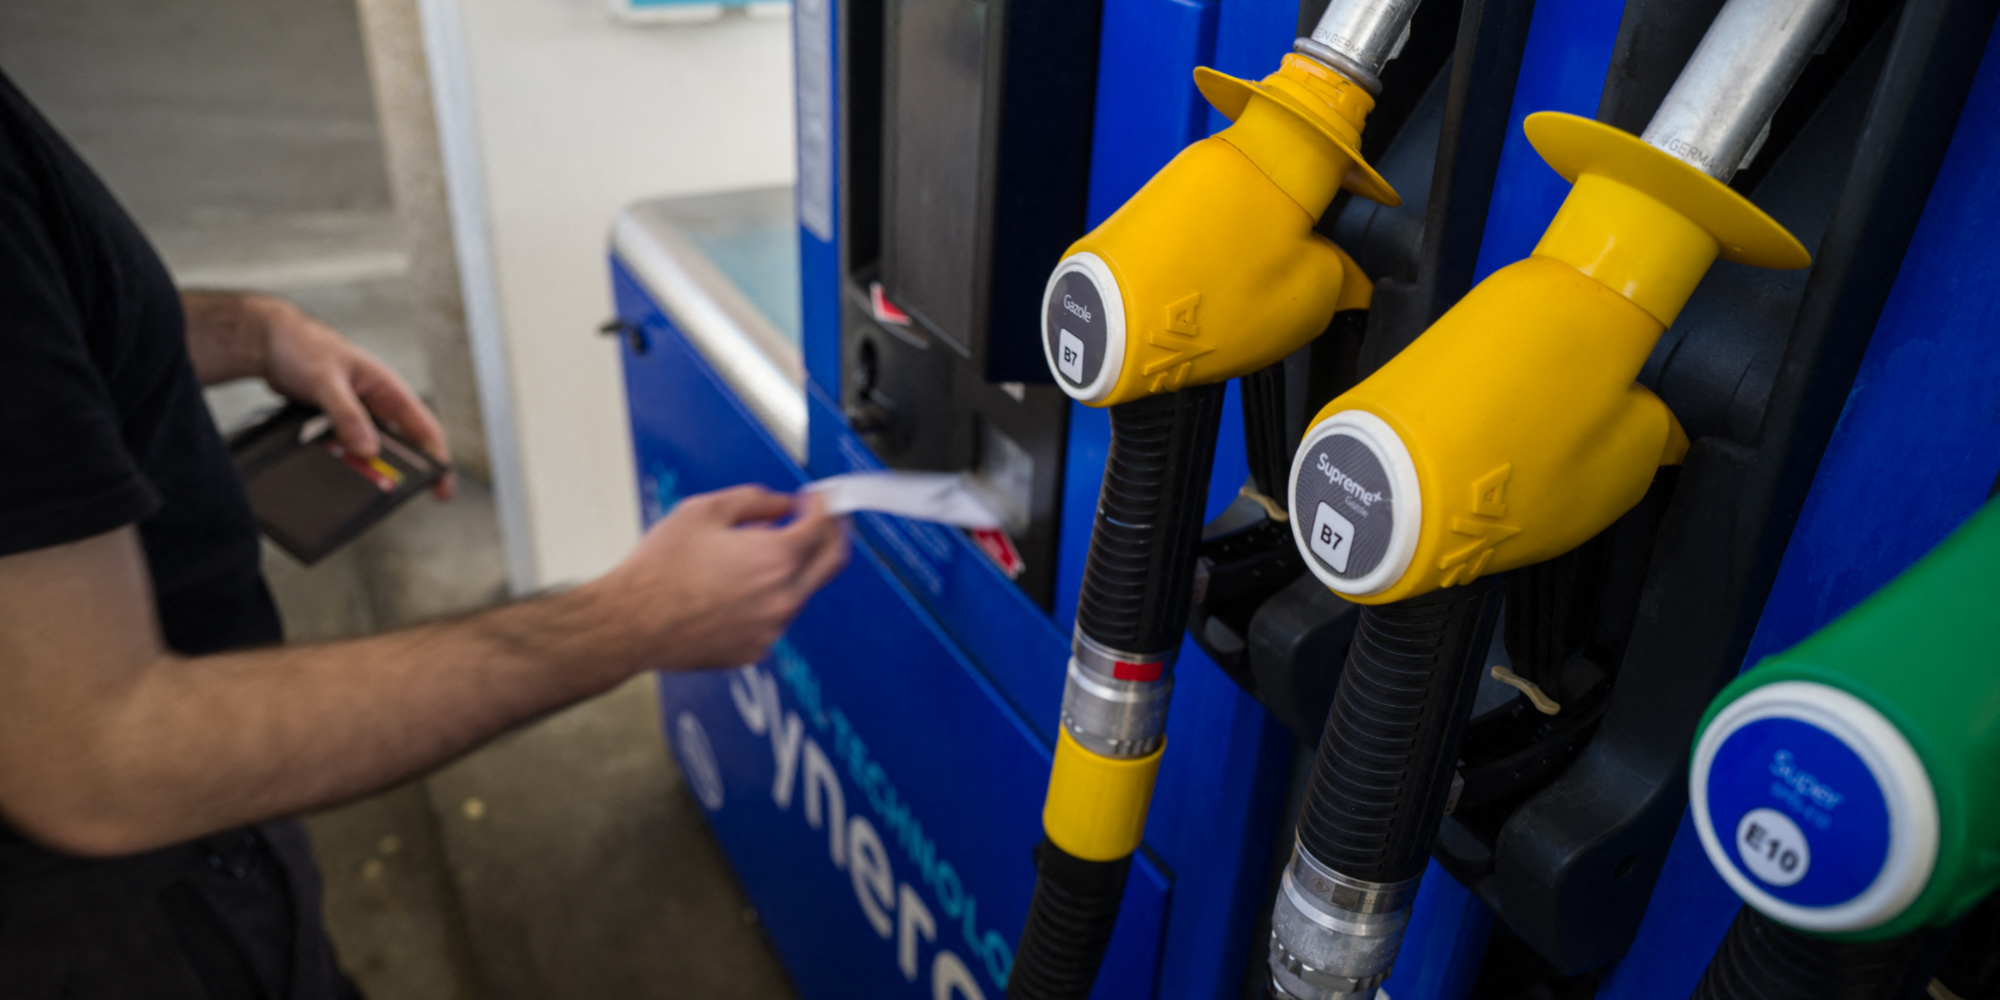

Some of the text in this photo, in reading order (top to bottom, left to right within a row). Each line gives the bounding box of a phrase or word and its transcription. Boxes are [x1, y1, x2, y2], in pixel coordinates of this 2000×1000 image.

[1064, 294, 1092, 324] Gazole
[1064, 345, 1078, 366] B7
[1320, 523, 1343, 550] B7
[1769, 749, 1844, 811] Super
[1745, 820, 1799, 874] E10
